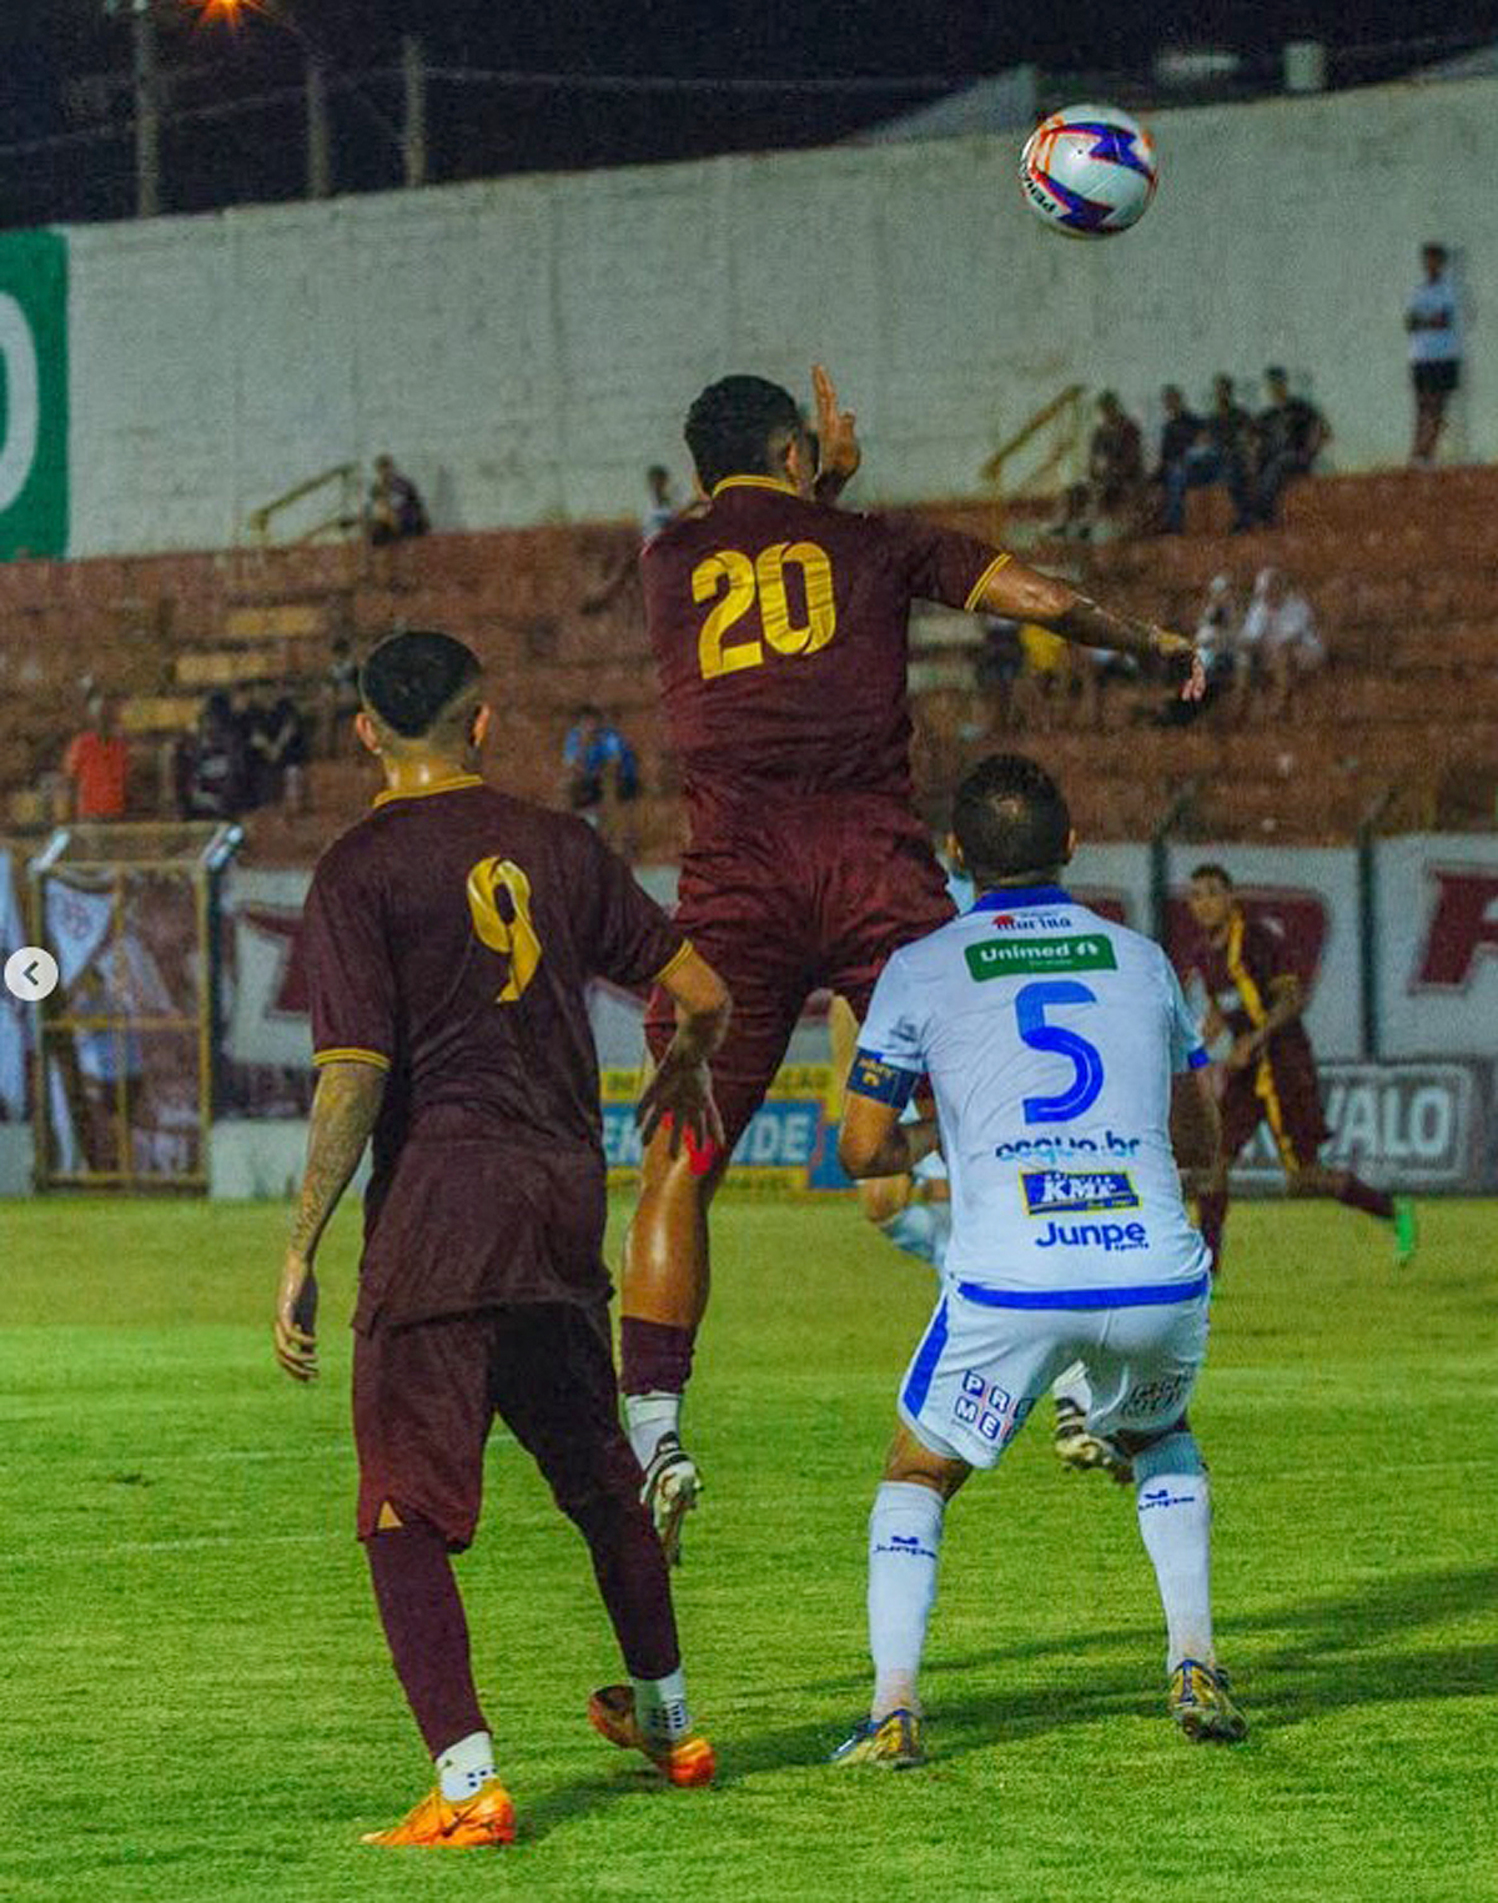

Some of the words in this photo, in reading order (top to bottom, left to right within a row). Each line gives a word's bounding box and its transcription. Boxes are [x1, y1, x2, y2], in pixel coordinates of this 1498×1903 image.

[692, 541, 836, 680] 20
[467, 857, 542, 1004] 9
[980, 943, 1070, 962] Unimed
[1015, 981, 1104, 1125] 5
[1035, 1222, 1146, 1250] Junpe
